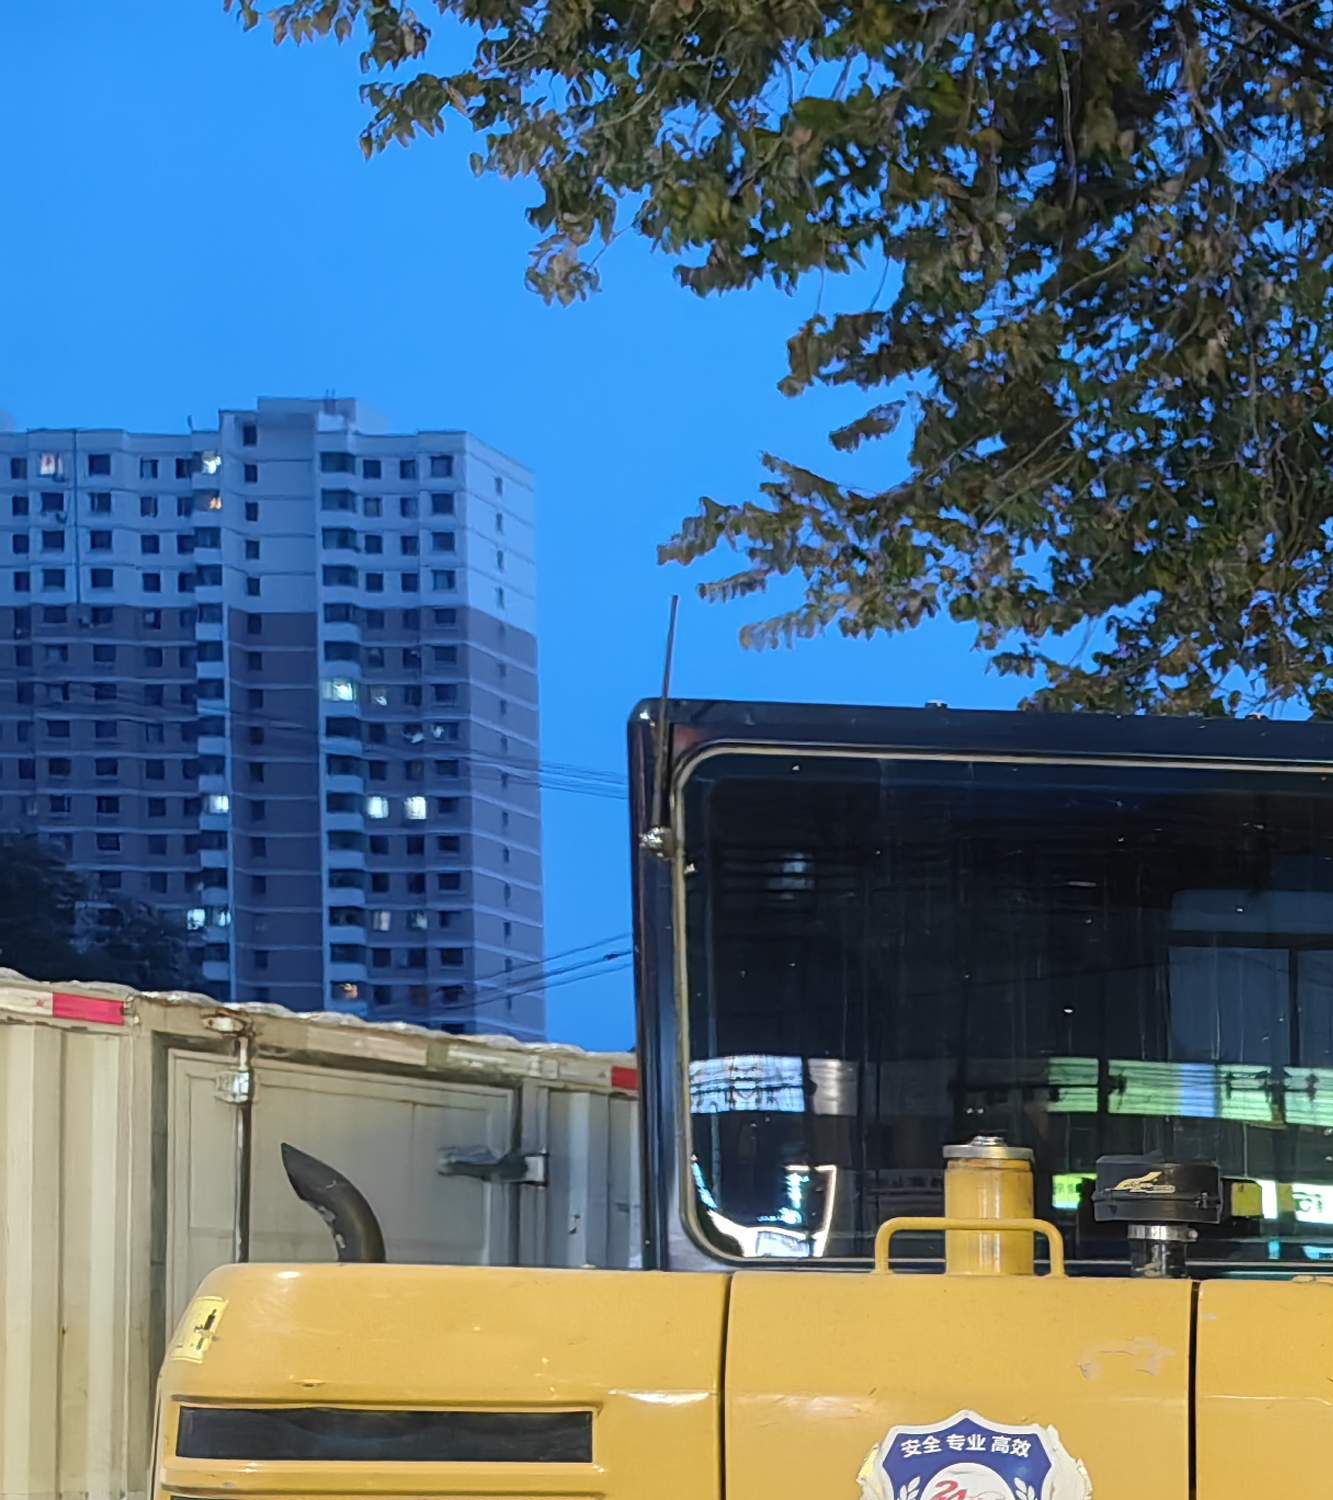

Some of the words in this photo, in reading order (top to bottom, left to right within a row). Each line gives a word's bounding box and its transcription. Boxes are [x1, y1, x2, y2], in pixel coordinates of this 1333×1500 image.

[900, 1435, 942, 1458] 安全
[946, 1434, 986, 1451] 专业
[990, 1435, 1032, 1458] 高效
